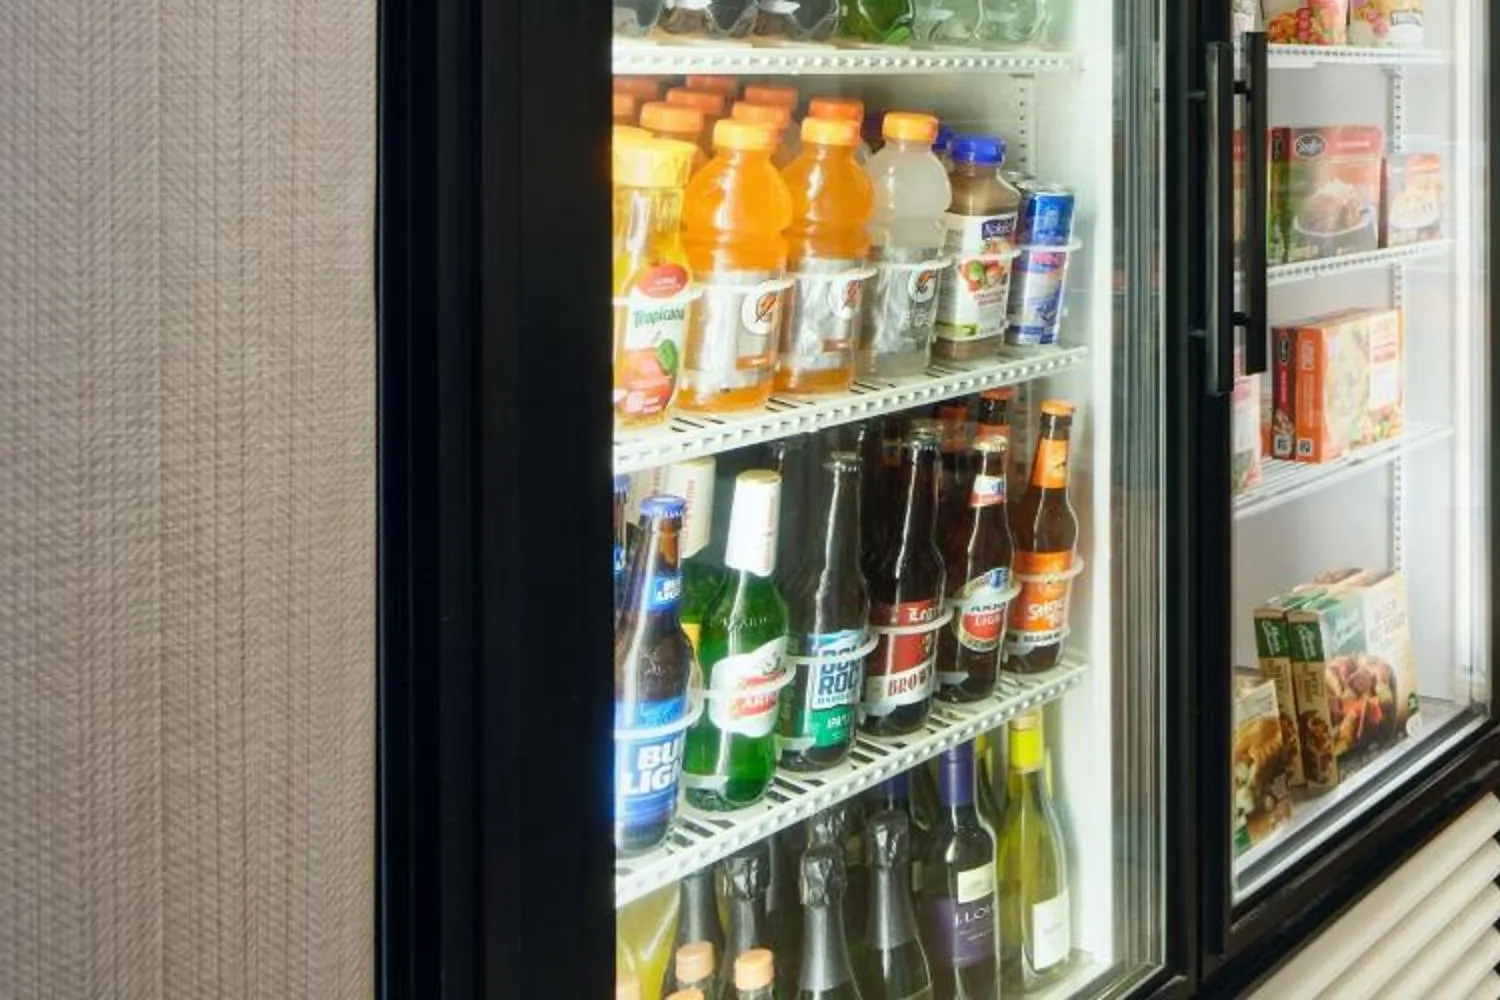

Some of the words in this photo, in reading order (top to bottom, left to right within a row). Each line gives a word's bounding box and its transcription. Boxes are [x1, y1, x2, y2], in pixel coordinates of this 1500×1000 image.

[818, 669, 857, 695] ROC
[638, 738, 681, 770] BU
[626, 762, 681, 796] LIG
